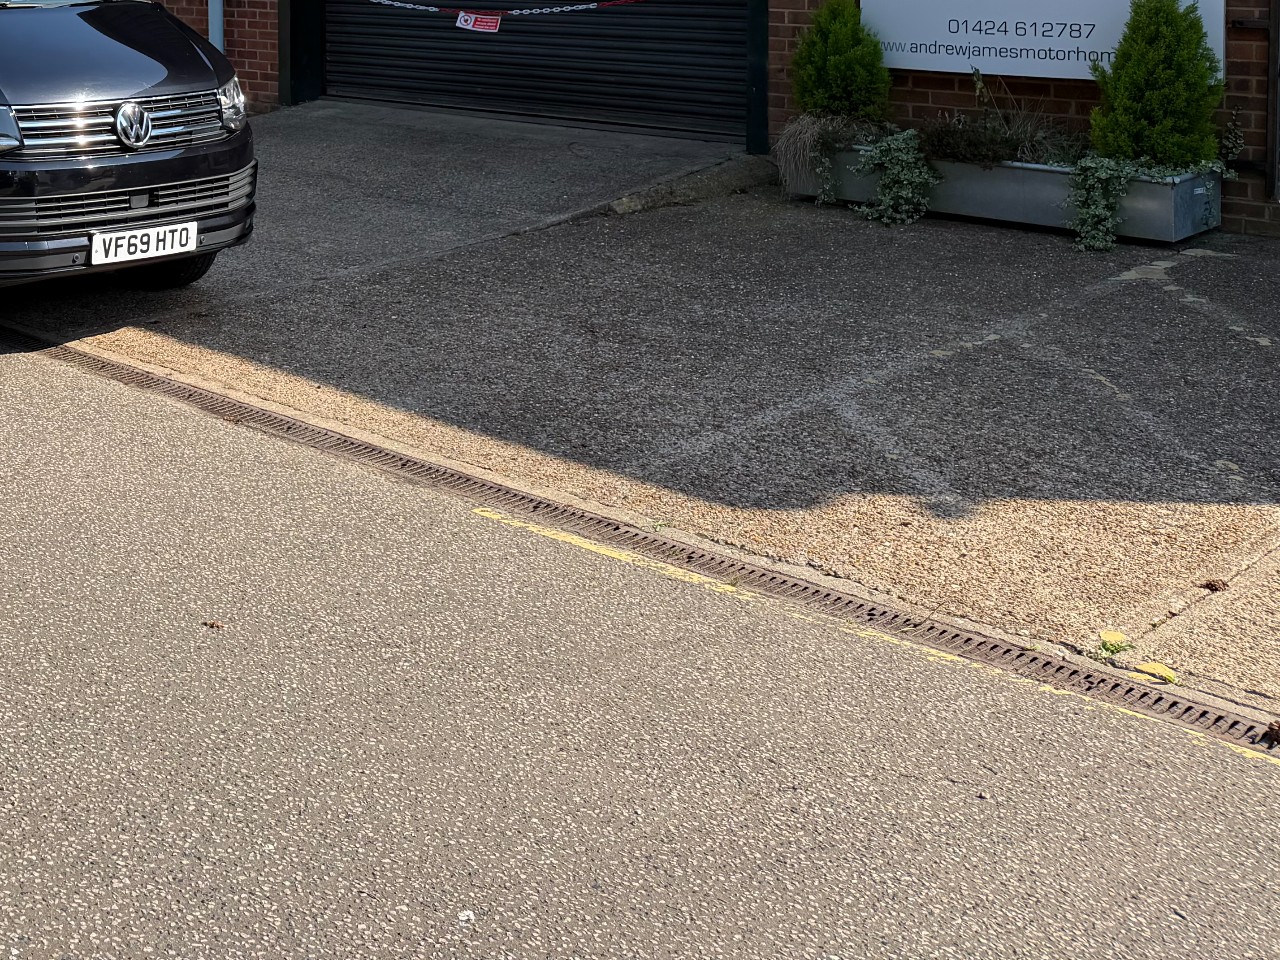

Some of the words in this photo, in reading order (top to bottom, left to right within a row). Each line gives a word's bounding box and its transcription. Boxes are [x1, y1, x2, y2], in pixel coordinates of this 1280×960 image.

[948, 19, 1009, 35] 01424
[1015, 21, 1096, 39] 612787
[880, 40, 1116, 63] ww.andrewjamesmotorhom
[102, 232, 151, 259] VF69
[155, 227, 189, 252] HTO
